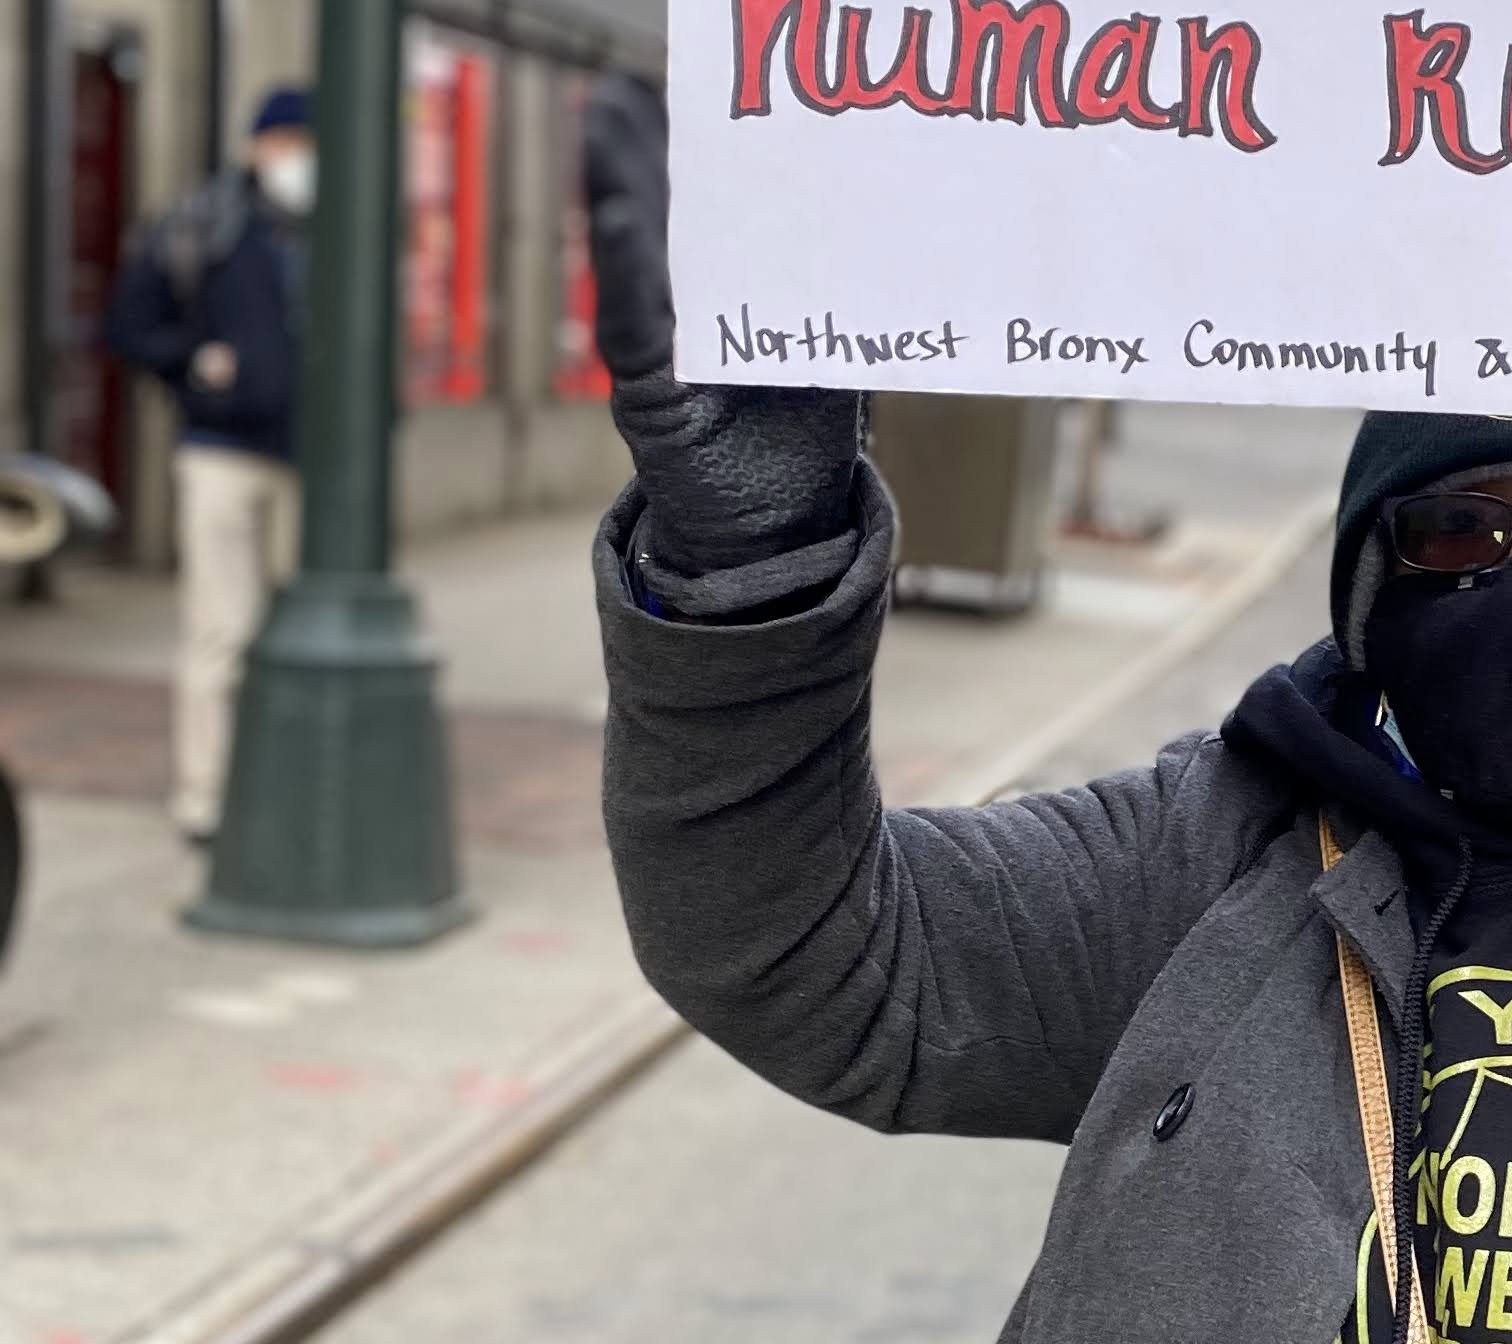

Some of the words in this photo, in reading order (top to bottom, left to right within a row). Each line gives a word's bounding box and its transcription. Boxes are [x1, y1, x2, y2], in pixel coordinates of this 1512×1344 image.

[717, 304, 966, 367] Northwest
[1006, 317, 1149, 373] Bronx
[1183, 319, 1437, 397] Community
[1474, 338, 1512, 379] &
